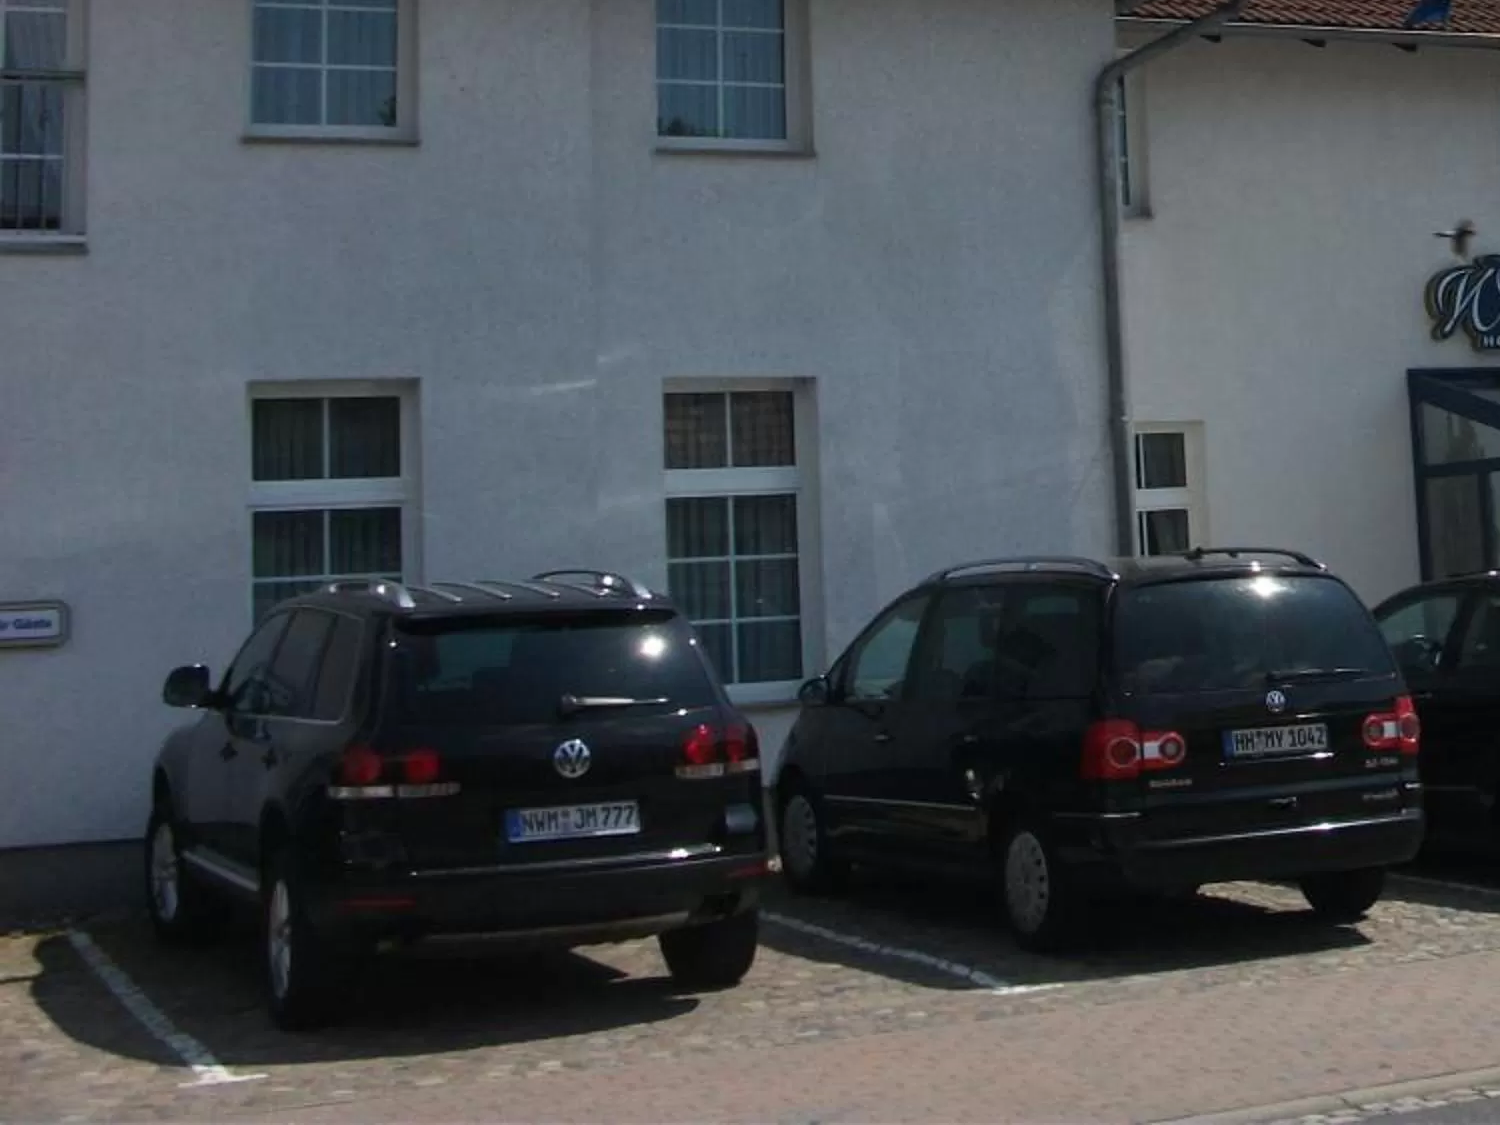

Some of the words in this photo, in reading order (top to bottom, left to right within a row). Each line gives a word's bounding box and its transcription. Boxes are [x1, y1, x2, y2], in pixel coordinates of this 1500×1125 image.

[1234, 730, 1256, 752] HH
[1264, 728, 1284, 749] MY
[1288, 726, 1326, 748] 1042
[520, 809, 560, 835] NWM
